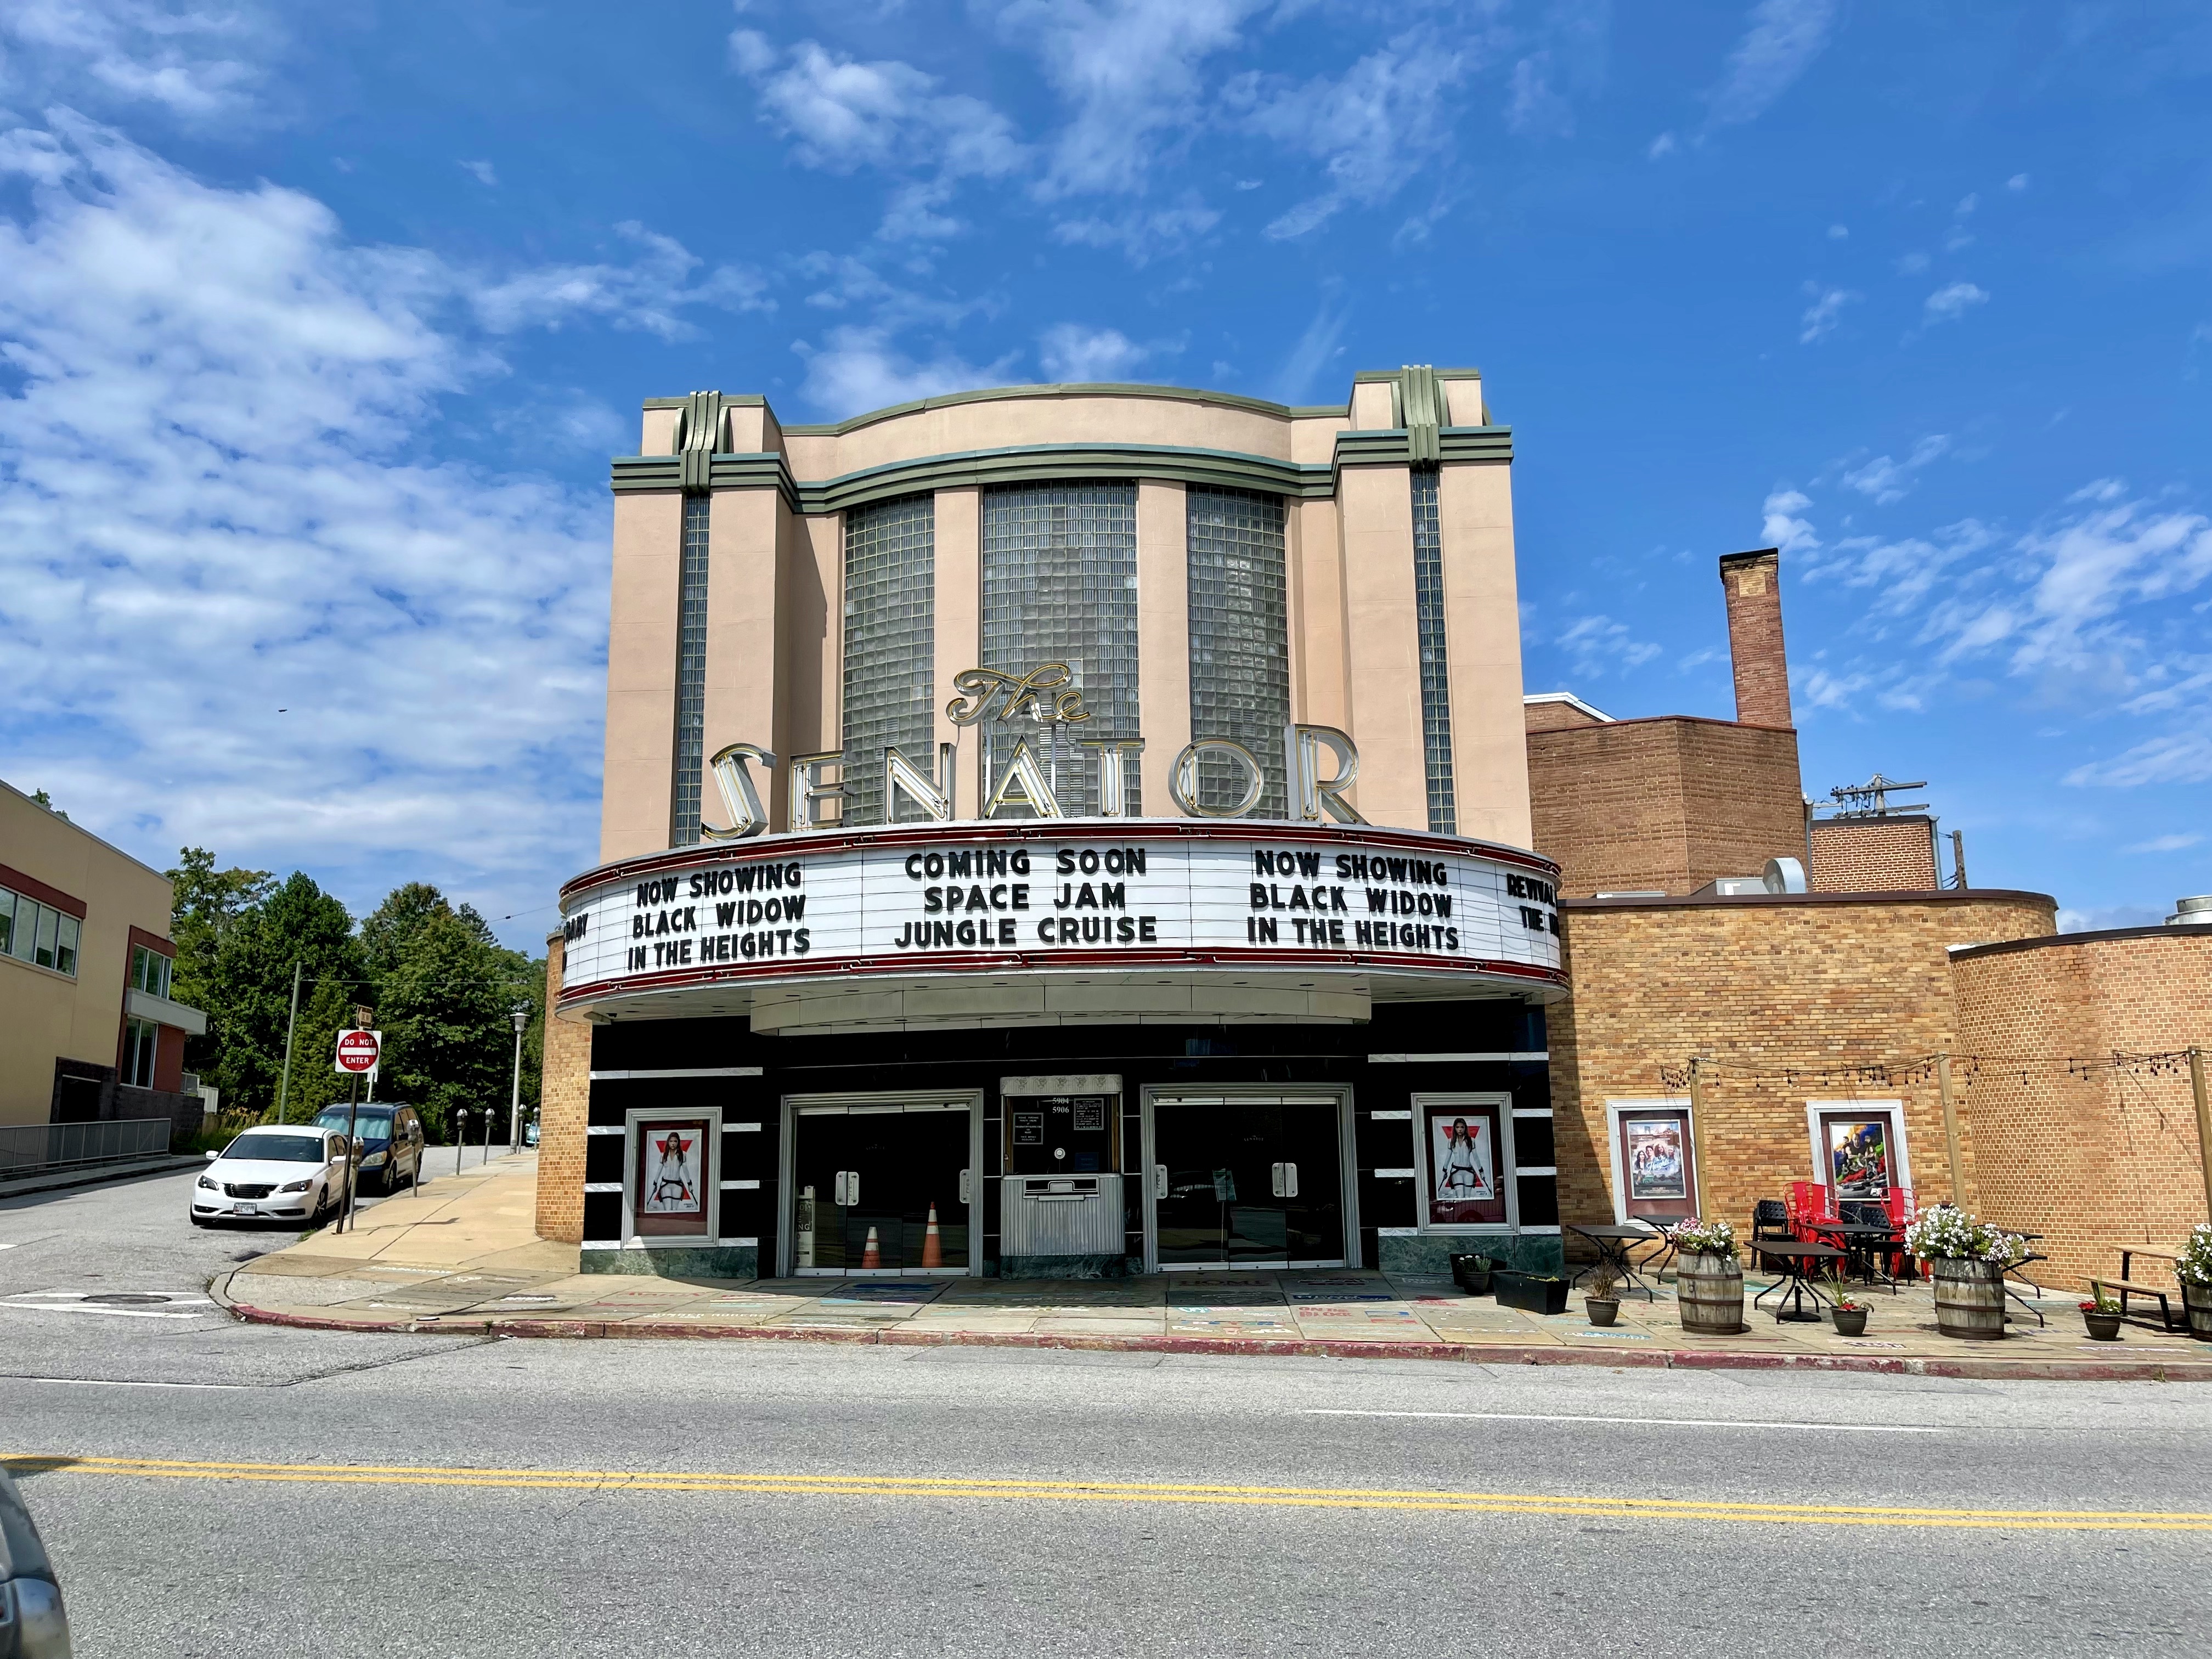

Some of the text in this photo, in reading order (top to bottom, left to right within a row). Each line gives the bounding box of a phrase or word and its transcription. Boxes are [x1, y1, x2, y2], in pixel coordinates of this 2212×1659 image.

[946, 663, 1091, 727] The
[701, 724, 1371, 840] SENATOR
[905, 848, 1146, 879] COMING SOON
[1255, 850, 1447, 886] NOW SHOWING
[637, 862, 801, 907] NOW SHOWING
[925, 883, 1125, 912] SPACE JAM
[1250, 883, 1452, 918] BLACK WIDOW
[633, 895, 806, 938] BLACK WIDOW
[895, 916, 1156, 947] JUNGLE CRUISE
[1248, 917, 1459, 950] IN THE HEIGHTS
[628, 928, 810, 970] IN THE HEIGHTS
[346, 1057, 369, 1065] ENTER
